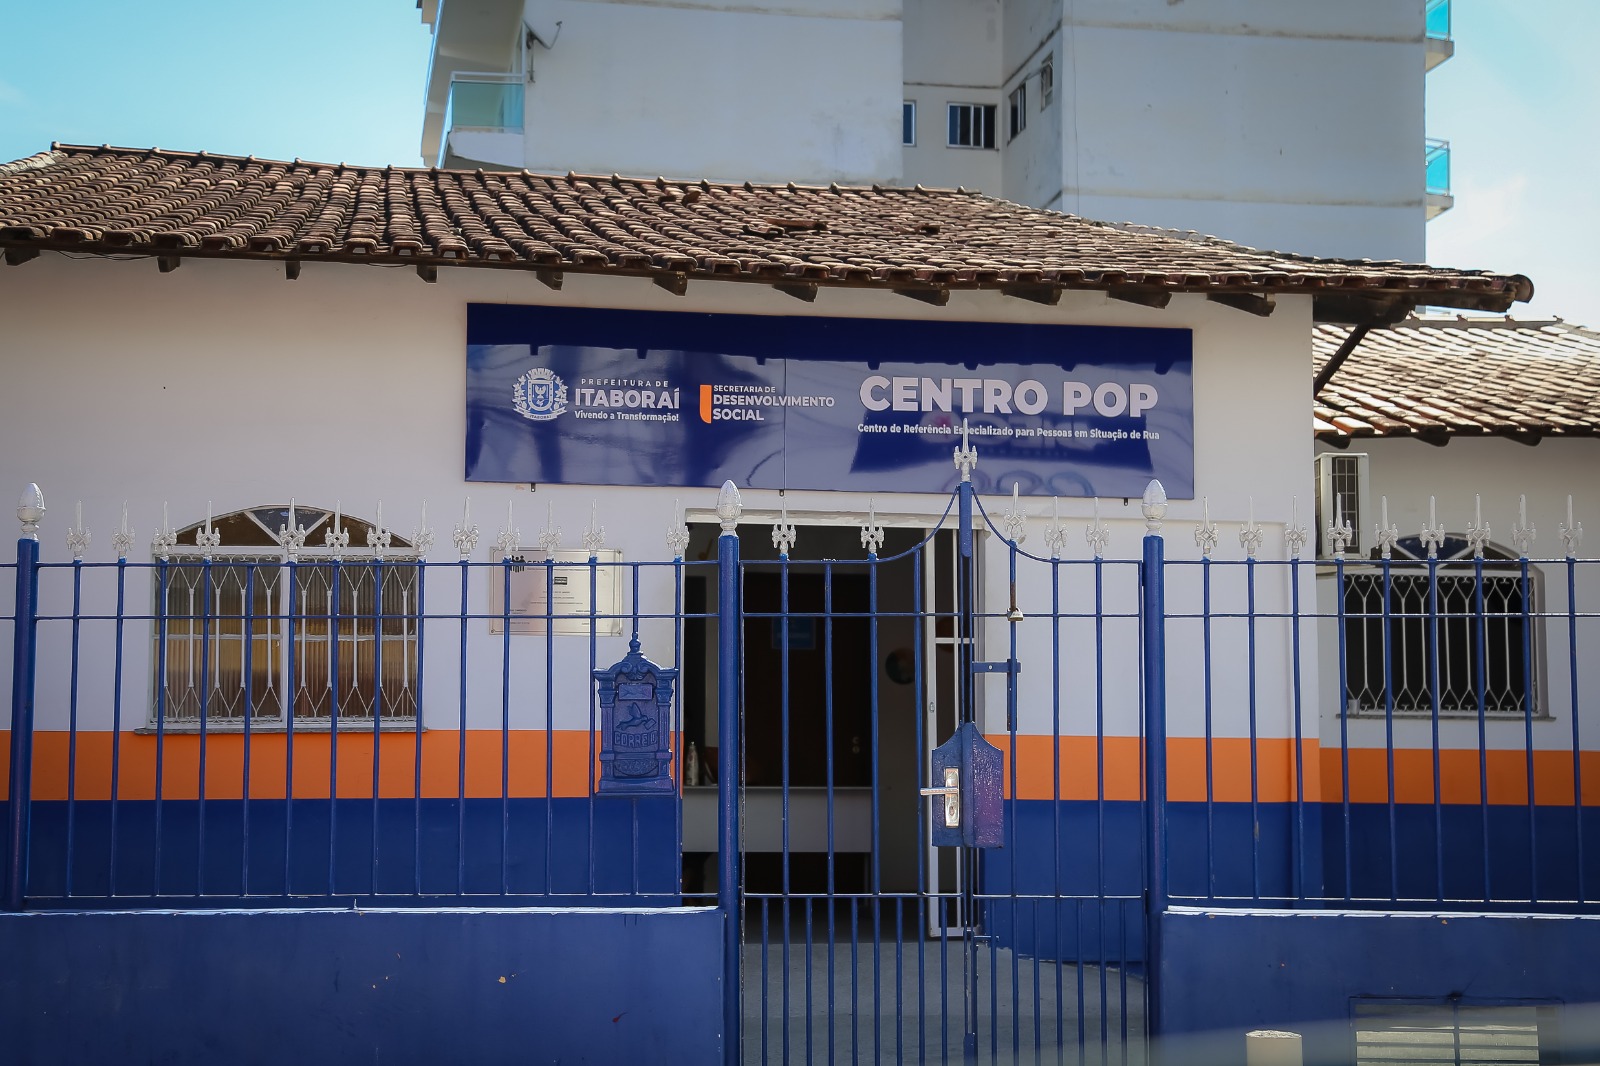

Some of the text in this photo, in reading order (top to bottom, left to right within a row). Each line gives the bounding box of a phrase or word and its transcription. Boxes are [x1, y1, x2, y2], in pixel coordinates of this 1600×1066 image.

[581, 378, 669, 388] PREFEITURA DE
[713, 384, 763, 393] SECRETARIA
[575, 387, 680, 409] ITABORAÍ
[713, 394, 835, 407] DESENVOLVIMENTO
[859, 375, 1159, 418] CENTRO POP
[574, 410, 679, 423] Vivendo a Transformação!
[712, 408, 765, 421] SOCIAL
[857, 423, 888, 433] Centro
[889, 424, 902, 433] de
[903, 424, 952, 435] Referência
[1015, 428, 1035, 438] para
[1036, 428, 1073, 438] Pessoas
[1074, 430, 1088, 438] em
[1089, 428, 1128, 441] Situação
[1129, 430, 1141, 439] de
[1143, 430, 1160, 440] Rua
[613, 730, 659, 748] CORREIO
